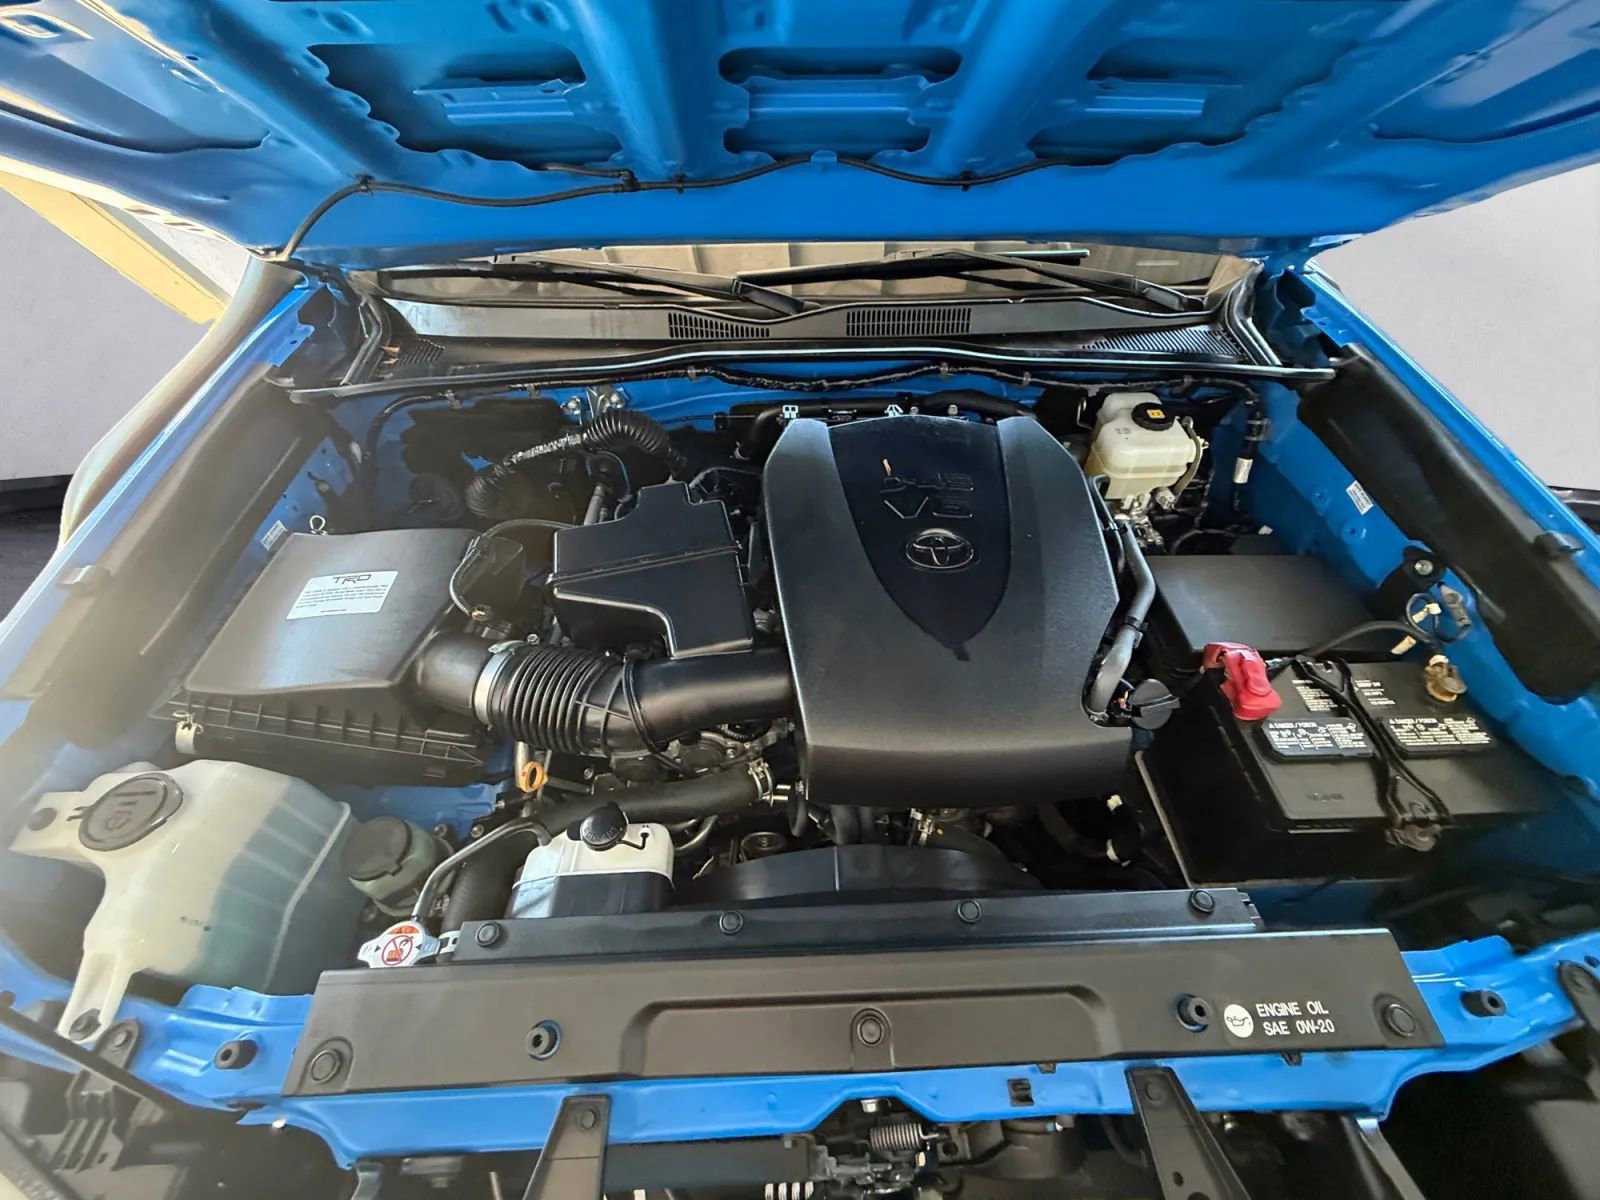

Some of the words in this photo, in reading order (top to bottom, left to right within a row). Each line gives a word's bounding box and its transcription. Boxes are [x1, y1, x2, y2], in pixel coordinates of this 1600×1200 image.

[332, 573, 372, 585] TRD
[1255, 1002, 1303, 1018] ENGINE
[1306, 1000, 1330, 1015] OIL
[1262, 1020, 1291, 1036] SAE
[1295, 1018, 1336, 1034] 0W-20
